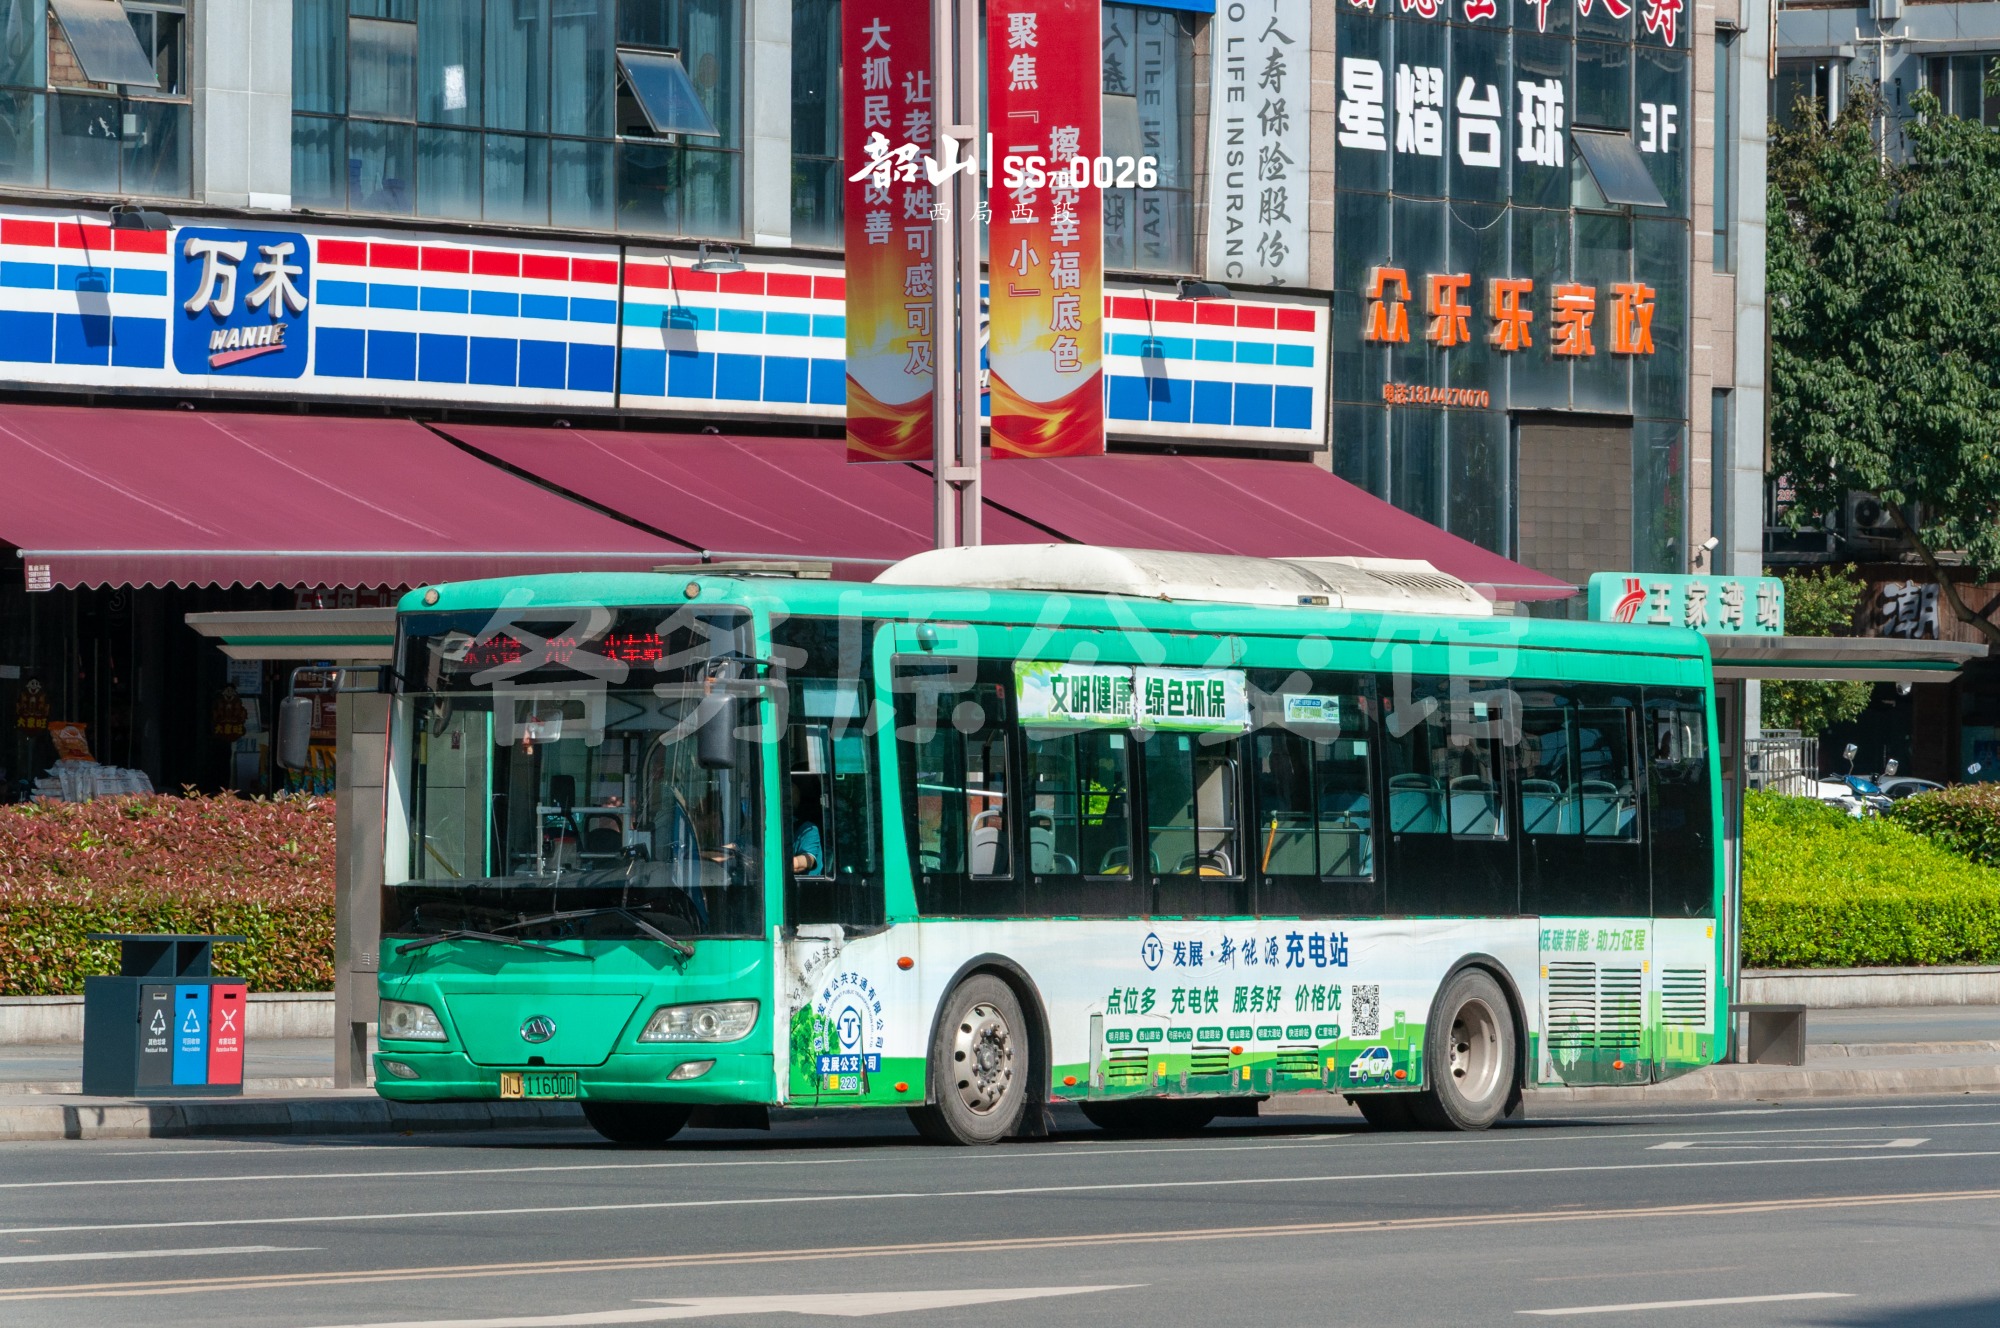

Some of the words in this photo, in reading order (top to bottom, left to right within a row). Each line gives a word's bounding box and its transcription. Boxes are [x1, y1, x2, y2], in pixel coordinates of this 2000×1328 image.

[1226, 36, 1245, 104] LIFE
[1338, 57, 1565, 168] 星熠台球
[1640, 102, 1678, 154] 3F
[1225, 117, 1244, 280] INSURANC
[183, 237, 309, 319] 万禾
[208, 322, 289, 351] WANHE
[1364, 265, 1656, 356] 众乐乐家政
[1647, 581, 1781, 630] 王家湾站
[1050, 674, 1132, 714] 文明健康
[1145, 676, 1226, 718] 绿色环保
[1106, 986, 1157, 1016] 点位多
[1170, 986, 1219, 1015] 充电快
[1232, 985, 1282, 1013] 服务好
[1295, 984, 1342, 1012] 价格优
[840, 1077, 857, 1090] 228
